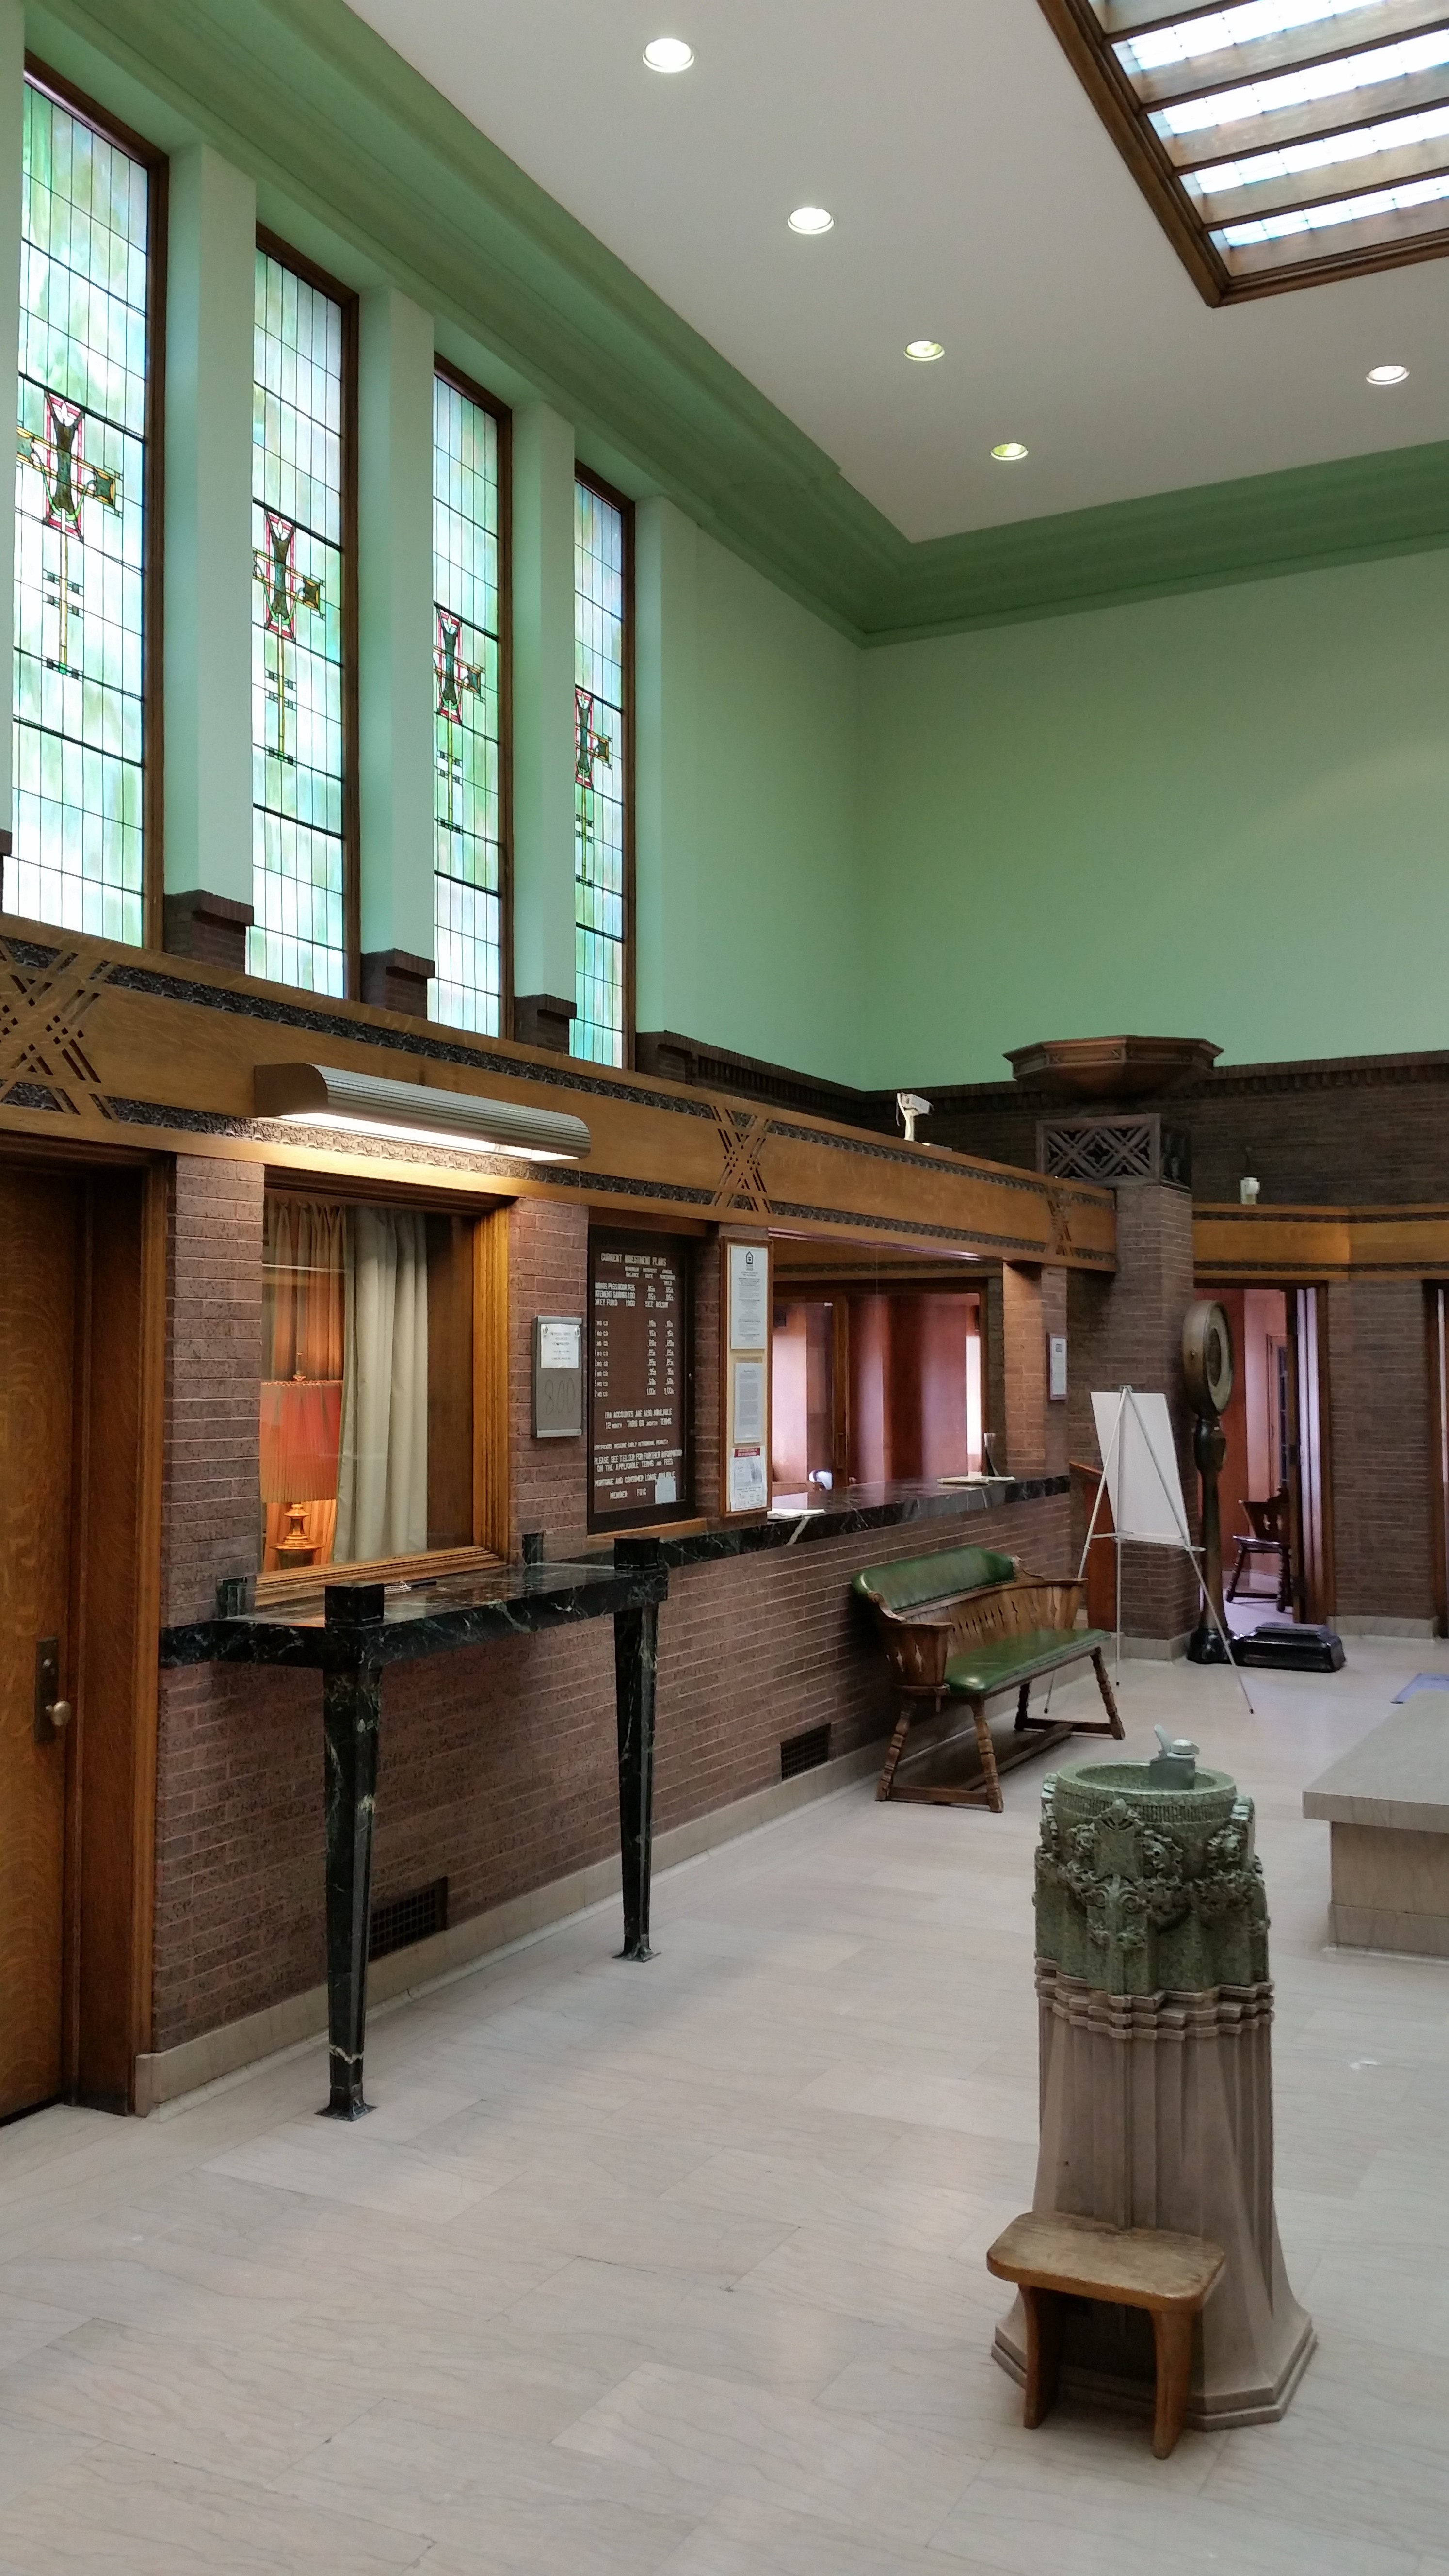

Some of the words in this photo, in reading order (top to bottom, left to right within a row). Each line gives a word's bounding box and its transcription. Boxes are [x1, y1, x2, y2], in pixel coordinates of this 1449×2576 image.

[601, 1253, 622, 1263] CURRENT
[625, 1254, 650, 1265] INVESTMENT
[652, 1257, 666, 1267] PLANS
[545, 1378, 575, 1415] 800
[613, 1410, 634, 1418] ACCOUNTS
[594, 1456, 609, 1465] PLEASE
[644, 1451, 660, 1460] FURTHER
[661, 1449, 682, 1458] INFORMATION
[615, 1461, 639, 1471] APPLICABLE
[595, 1478, 614, 1487] MORTGAGE
[625, 1475, 644, 1483] CONSUMER
[645, 1473, 657, 1481] LOANS
[610, 1490, 628, 1499] MEMBER
[636, 1488, 647, 1497] FDIC
